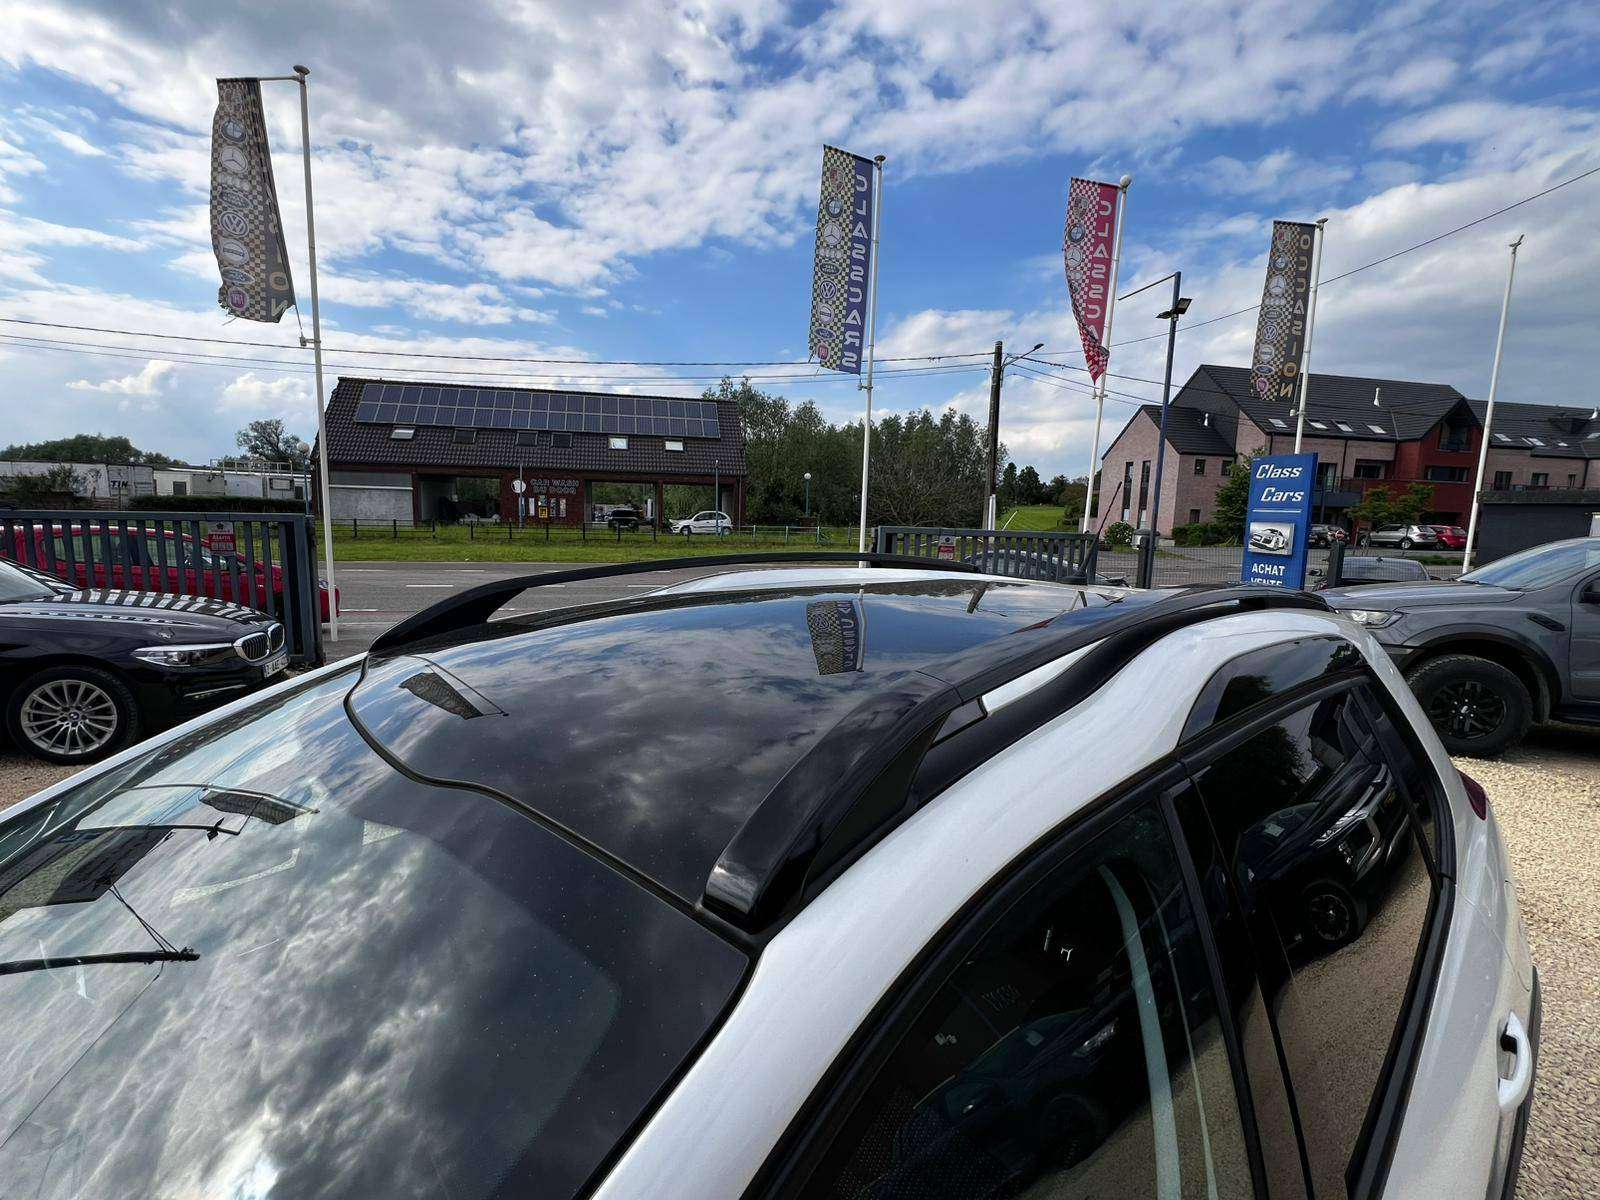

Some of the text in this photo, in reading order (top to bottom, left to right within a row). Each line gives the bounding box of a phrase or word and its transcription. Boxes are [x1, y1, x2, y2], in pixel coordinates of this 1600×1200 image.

[1255, 463, 1303, 479] Class
[1260, 487, 1305, 502] Cars
[1251, 563, 1286, 577] ACHAT
